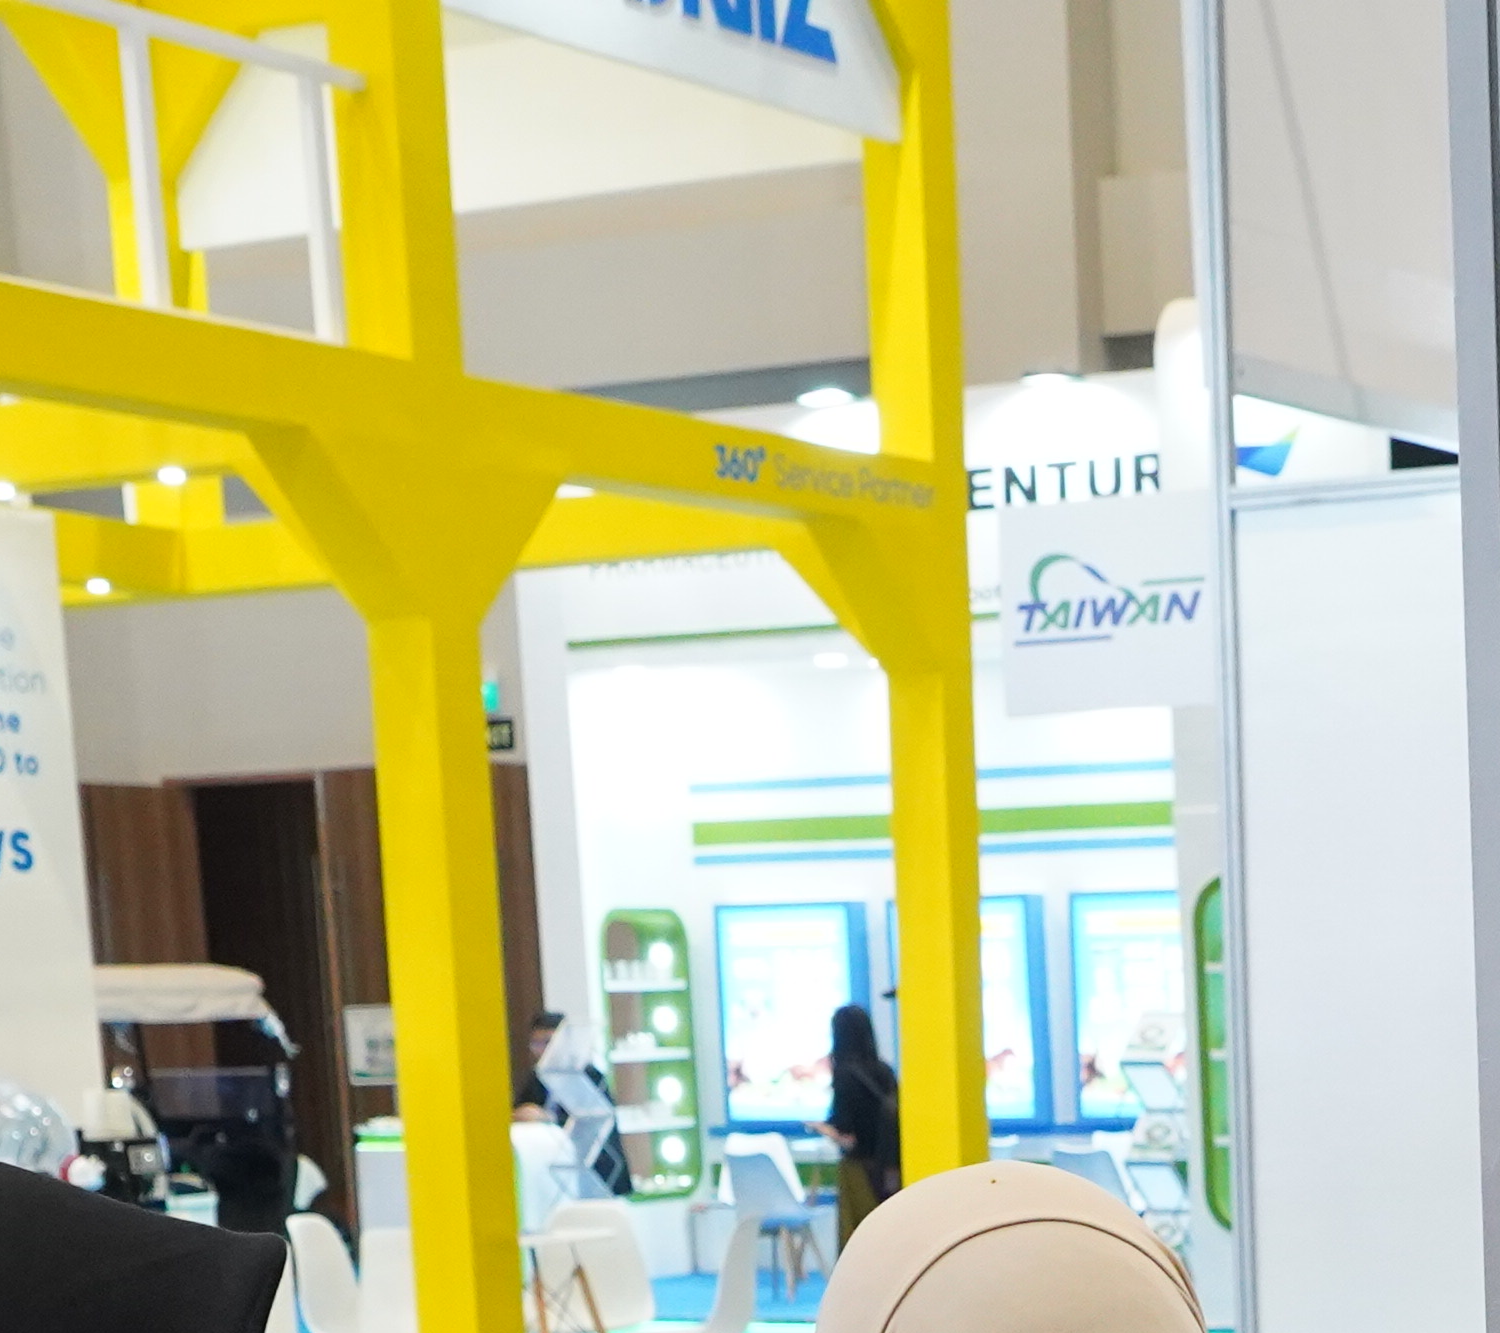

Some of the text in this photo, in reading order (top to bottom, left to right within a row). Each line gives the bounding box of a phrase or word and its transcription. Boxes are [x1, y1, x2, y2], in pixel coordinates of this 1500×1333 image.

[966, 453, 1161, 511] ENTUR
[1016, 589, 1201, 633] TAIWAN
[14, 749, 40, 776] to
